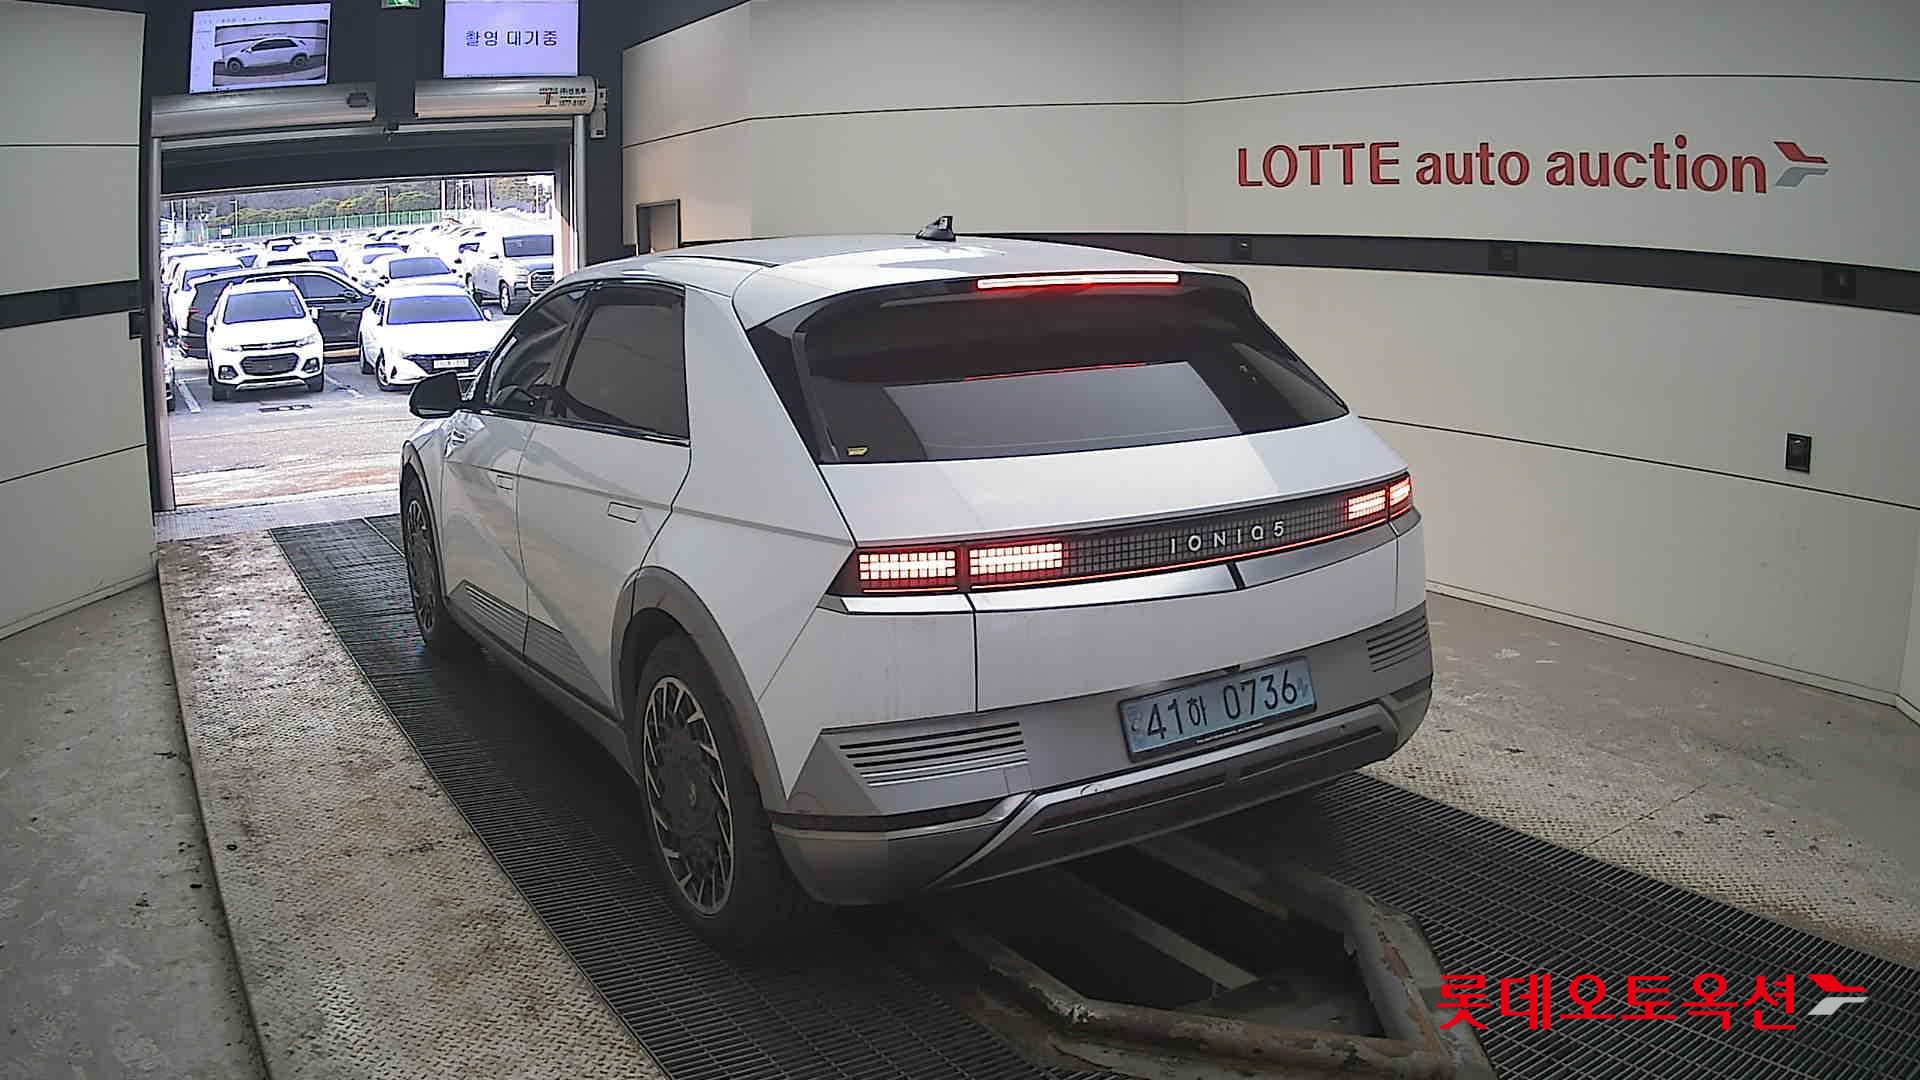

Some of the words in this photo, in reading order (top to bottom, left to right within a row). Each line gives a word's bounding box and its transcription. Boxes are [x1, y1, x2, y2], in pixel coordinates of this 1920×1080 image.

[465, 30, 498, 46] 촬영
[1237, 142, 1400, 188] LOTTE
[1415, 142, 1530, 186] auto
[1545, 134, 1768, 194] auction
[1222, 669, 1298, 719] 0736
